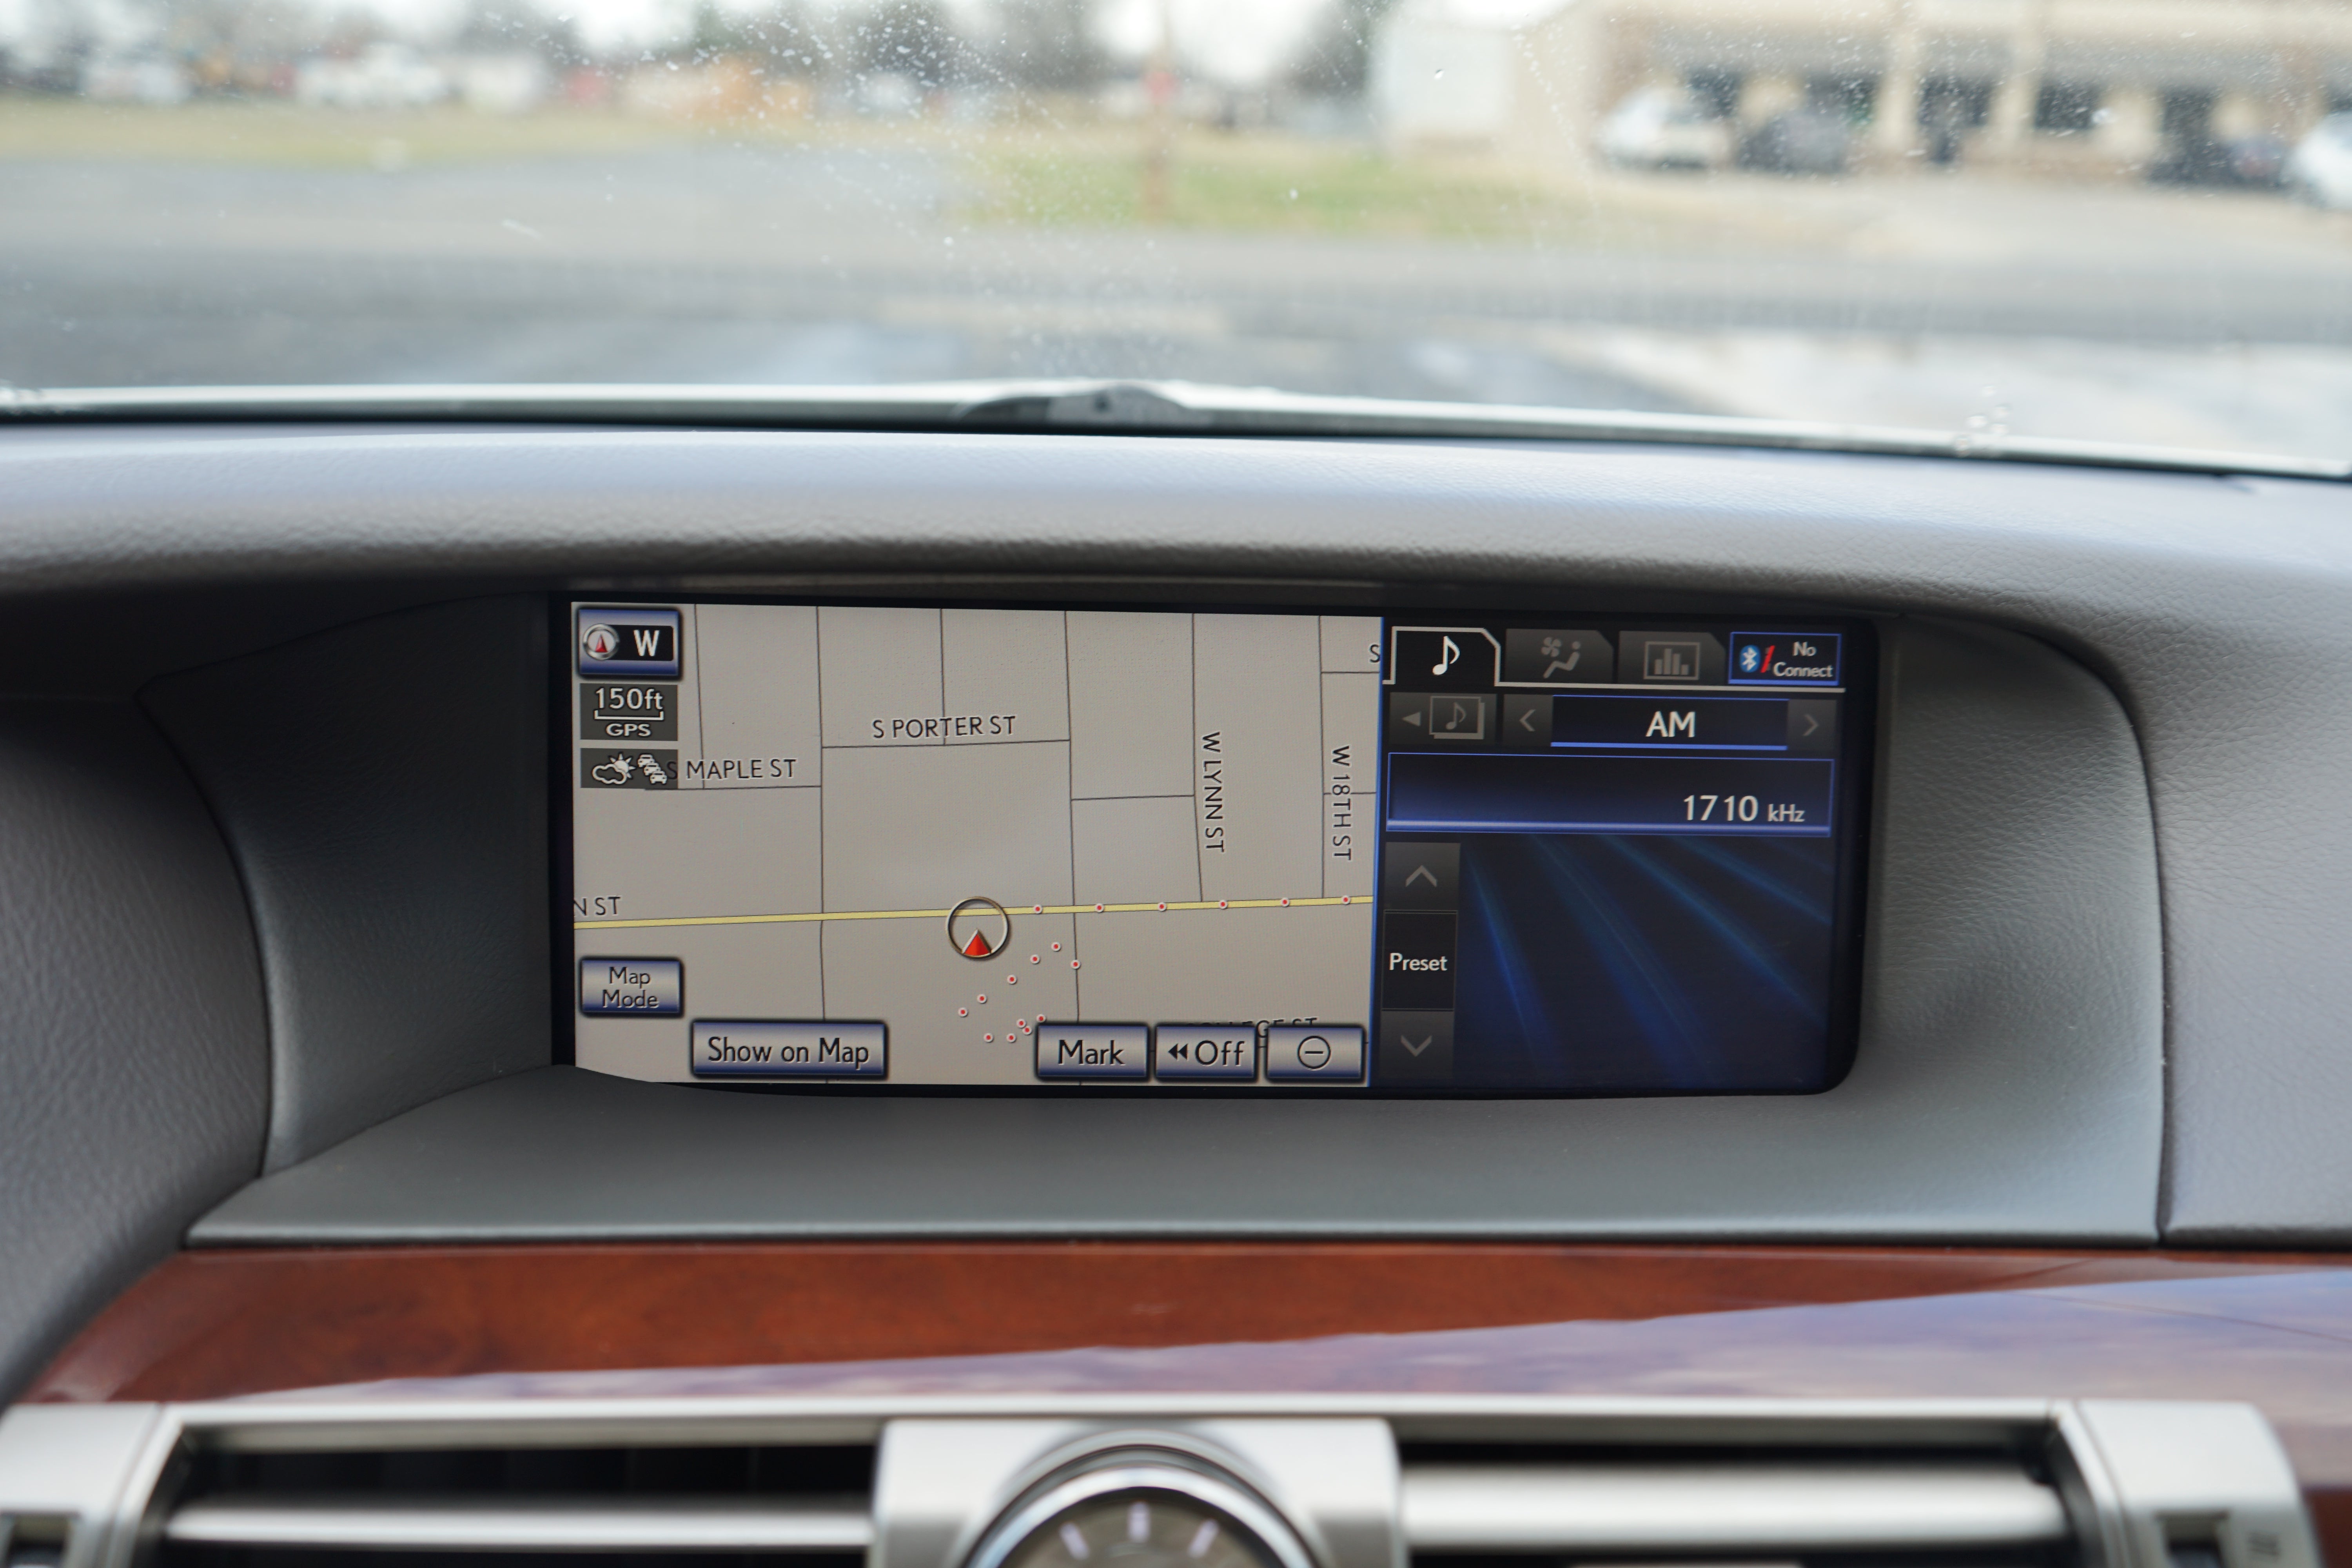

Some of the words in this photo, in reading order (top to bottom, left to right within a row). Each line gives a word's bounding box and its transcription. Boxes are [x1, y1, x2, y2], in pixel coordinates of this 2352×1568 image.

[634, 630, 659, 657] W
[1793, 641, 1817, 656] No
[1773, 662, 1833, 677] Connect
[595, 688, 663, 710] 150ft
[606, 723, 651, 737] GPS
[873, 720, 884, 738] S
[892, 717, 984, 738] PORTER
[989, 716, 1015, 735] ST
[1646, 711, 1696, 738] AM
[1202, 731, 1220, 753] W
[1332, 745, 1350, 766] W
[687, 760, 762, 779] MAPLE
[770, 759, 796, 778] ST
[1203, 760, 1224, 820] LYNN
[1332, 773, 1351, 829] 18TH
[1683, 795, 1759, 822] 1710
[1768, 804, 1805, 823] kHz
[1205, 826, 1225, 852] ST
[1332, 835, 1352, 860] ST
[595, 897, 621, 915] ST
[1389, 953, 1447, 971] Preset
[609, 967, 651, 988] Map
[602, 989, 659, 1008] Mode
[708, 1036, 771, 1063] Show
[781, 1044, 809, 1063] on
[819, 1038, 869, 1069] Map
[1058, 1039, 1125, 1065] Mark
[1194, 1040, 1245, 1066] Off
